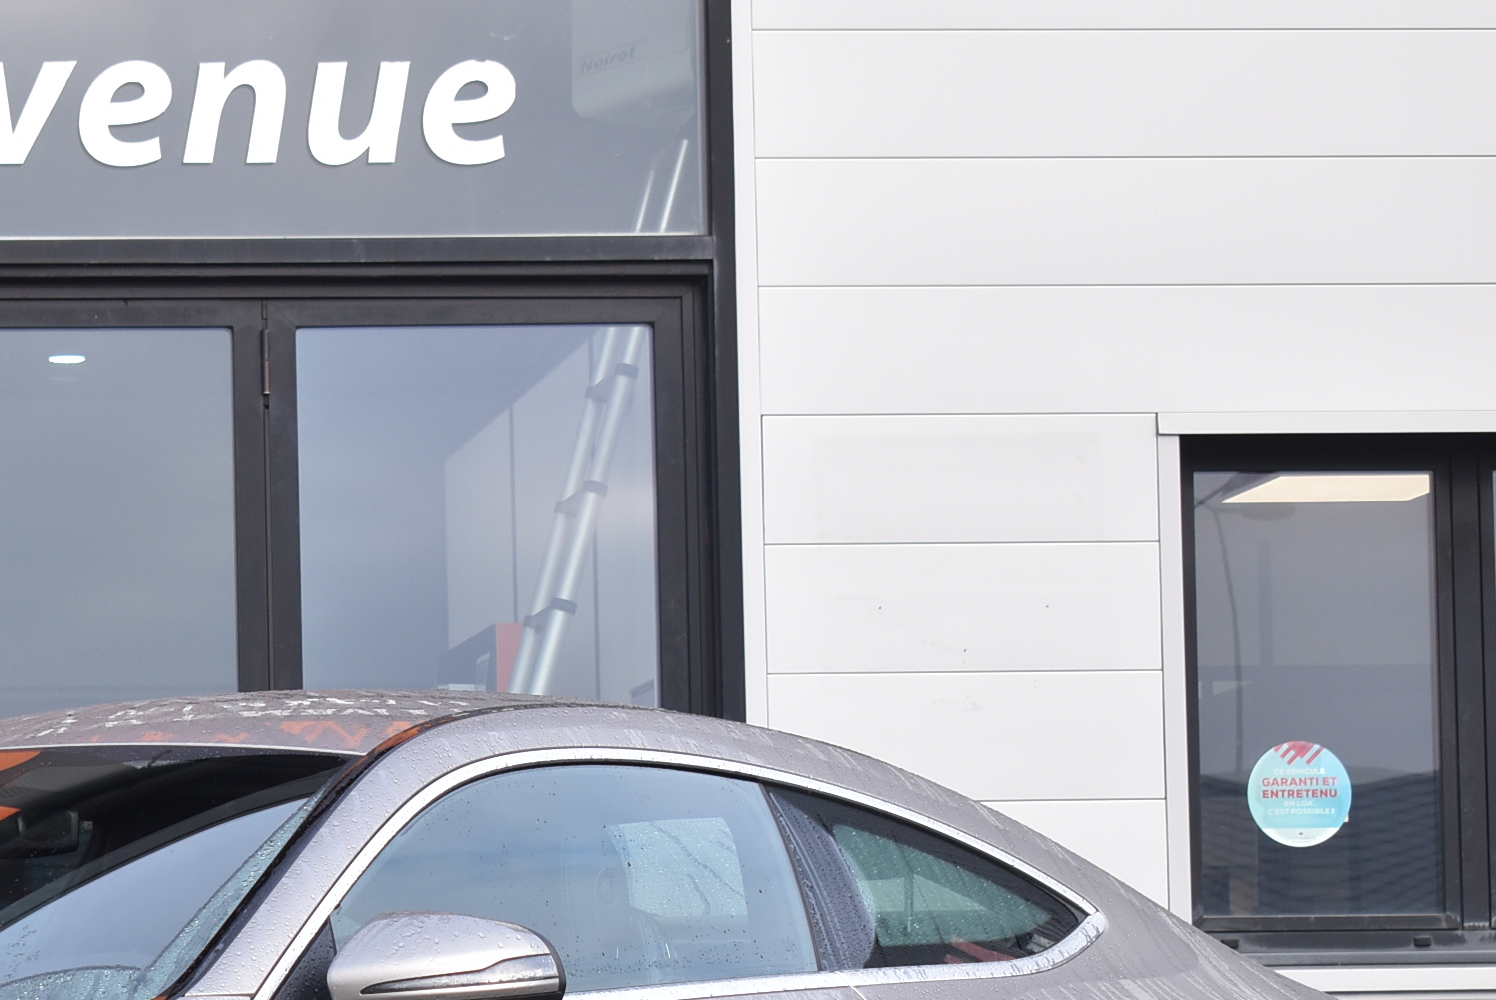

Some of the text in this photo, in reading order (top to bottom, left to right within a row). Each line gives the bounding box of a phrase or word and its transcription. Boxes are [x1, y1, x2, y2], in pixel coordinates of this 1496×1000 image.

[579, 46, 637, 74] Noirot
[1261, 776, 1337, 787] GARANTI ET
[1261, 788, 1338, 799] ENTRETENU
